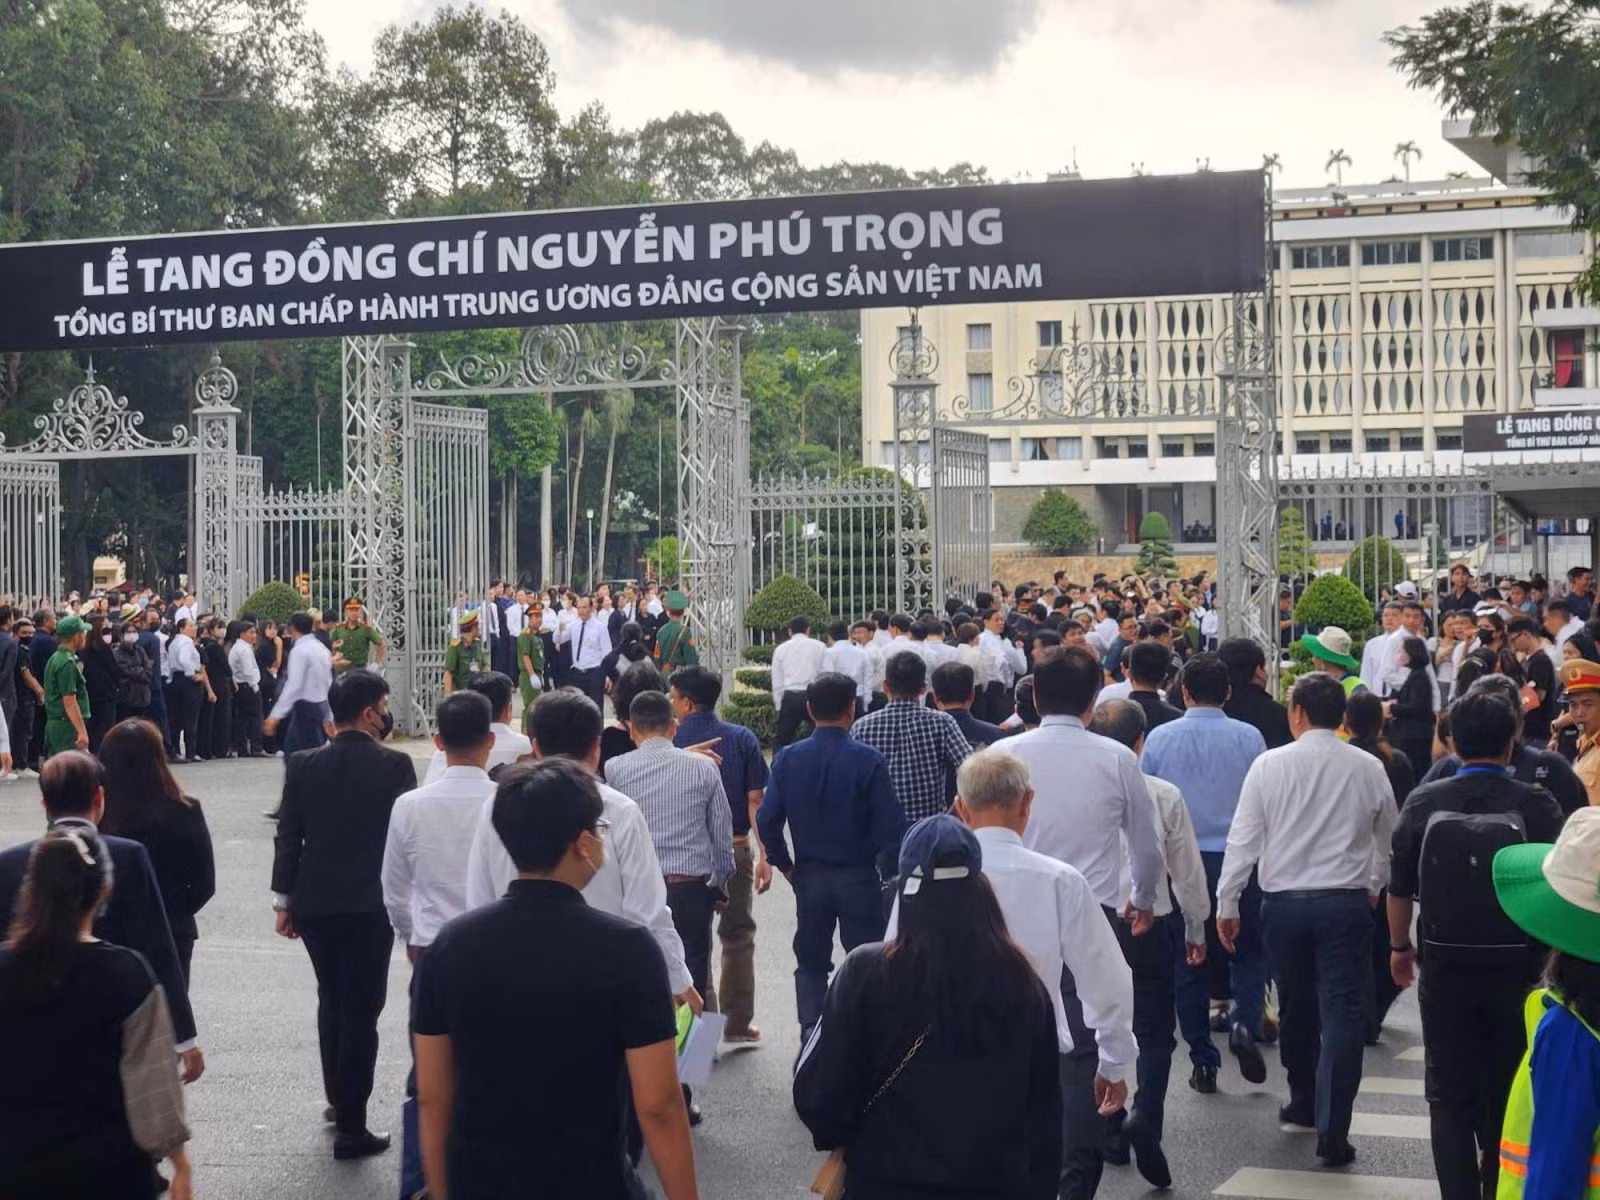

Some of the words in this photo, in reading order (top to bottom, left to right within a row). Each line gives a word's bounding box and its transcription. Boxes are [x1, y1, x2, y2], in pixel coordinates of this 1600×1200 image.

[82, 246, 130, 297] LỄ
[136, 252, 253, 293] TANG
[262, 236, 397, 286] ĐỒNG
[407, 230, 488, 277] CHÍ
[497, 212, 695, 273] NGUYỄN
[709, 210, 811, 260] PHÚ
[822, 207, 1003, 261] TRỌNG
[54, 305, 126, 338] TỔNG
[131, 307, 157, 334] BÍ
[159, 304, 216, 332] THƯ
[220, 303, 275, 329] BAN
[280, 292, 354, 326] CHẤP
[359, 293, 439, 322] HÀNH
[442, 289, 539, 317] TRUNG
[546, 282, 632, 312] ƯƠNG
[637, 274, 725, 306] ĐẢNG
[731, 271, 818, 307] CỘNG
[825, 264, 887, 297] SẢN
[893, 263, 961, 300] VIỆT
[968, 263, 1043, 291] NAM
[1515, 418, 1551, 433] TANG
